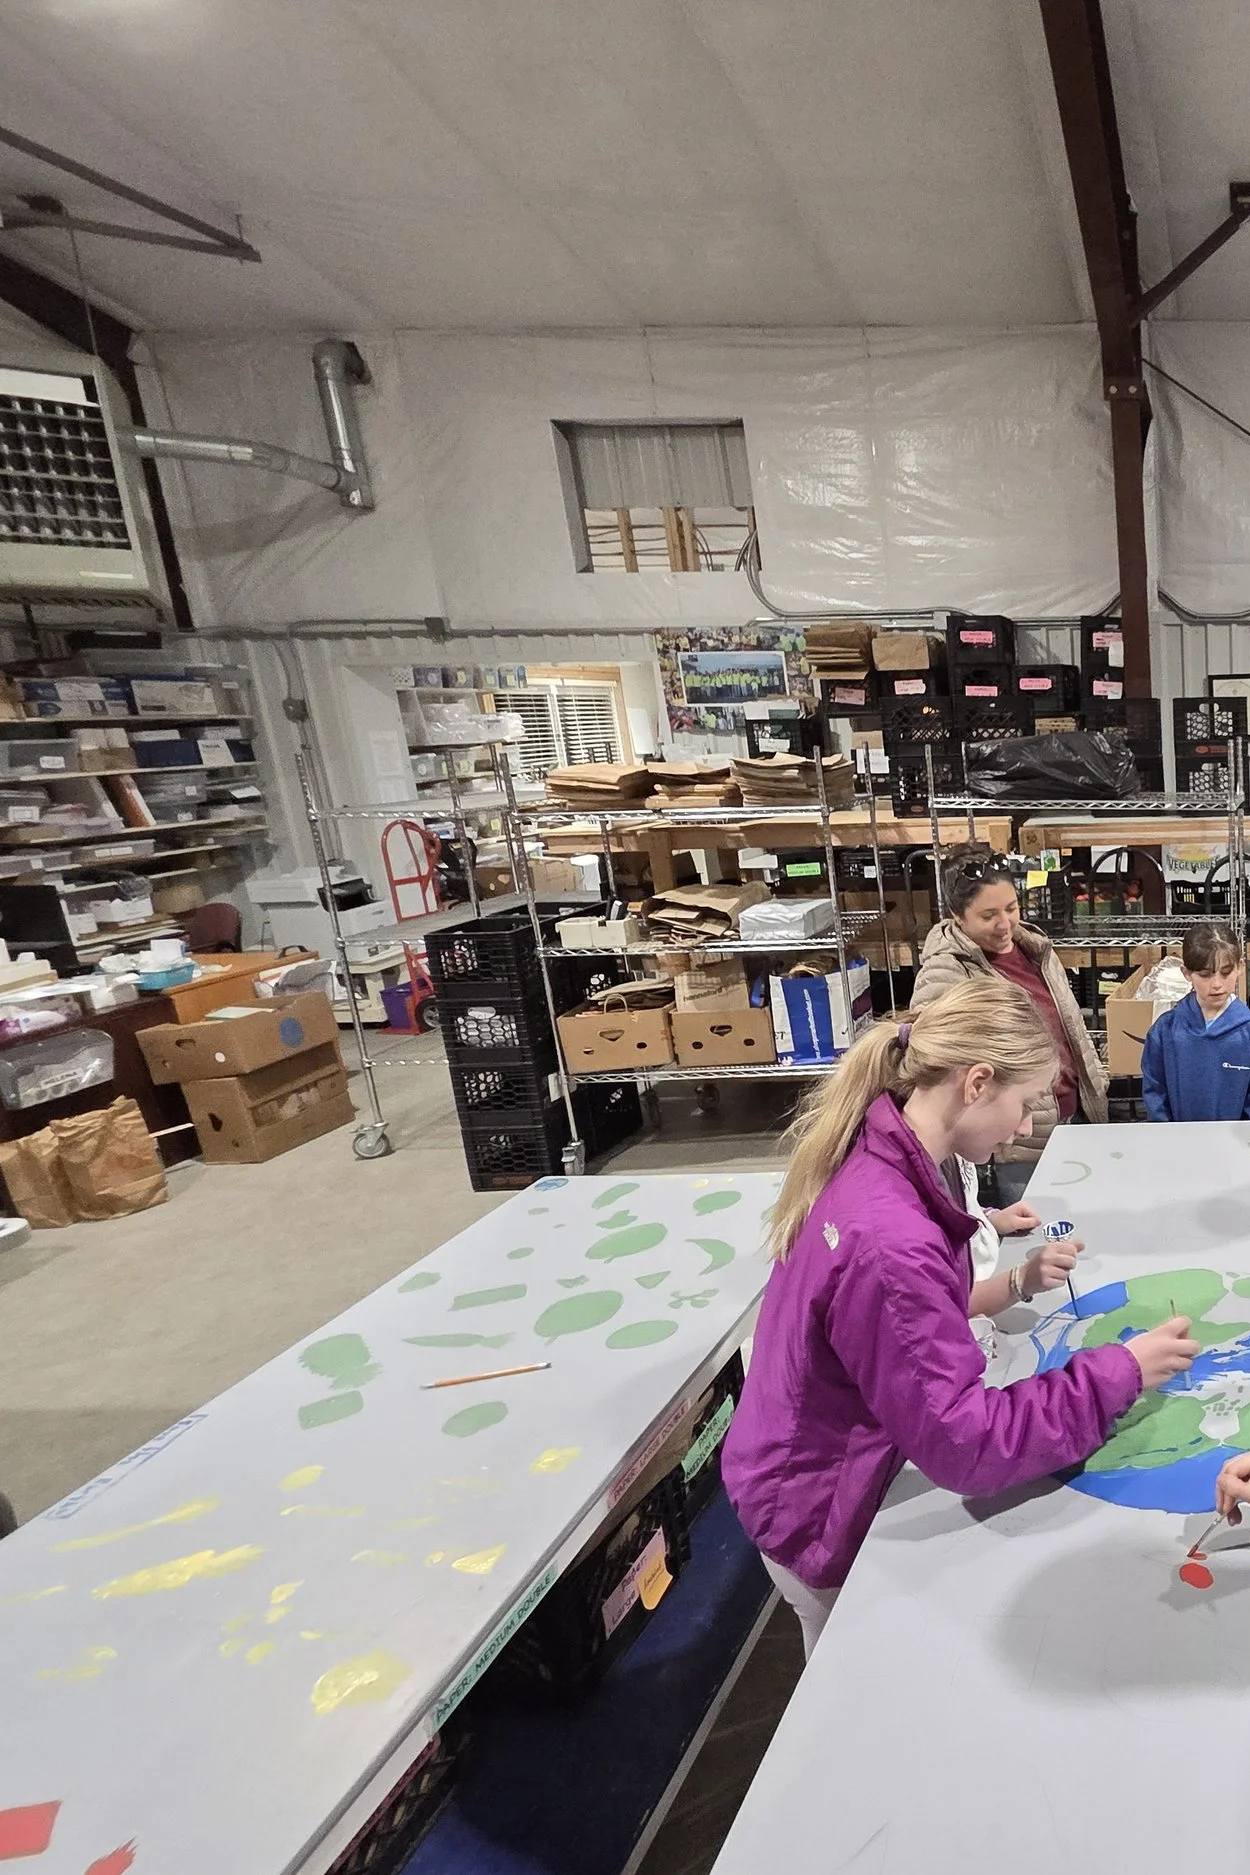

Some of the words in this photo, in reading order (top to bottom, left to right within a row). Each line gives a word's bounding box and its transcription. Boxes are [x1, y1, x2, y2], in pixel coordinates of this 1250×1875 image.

[435, 1675, 473, 1722] PAPER:
[474, 1619, 516, 1673] MEDIUM
[516, 1573, 551, 1621] DOUBLE
